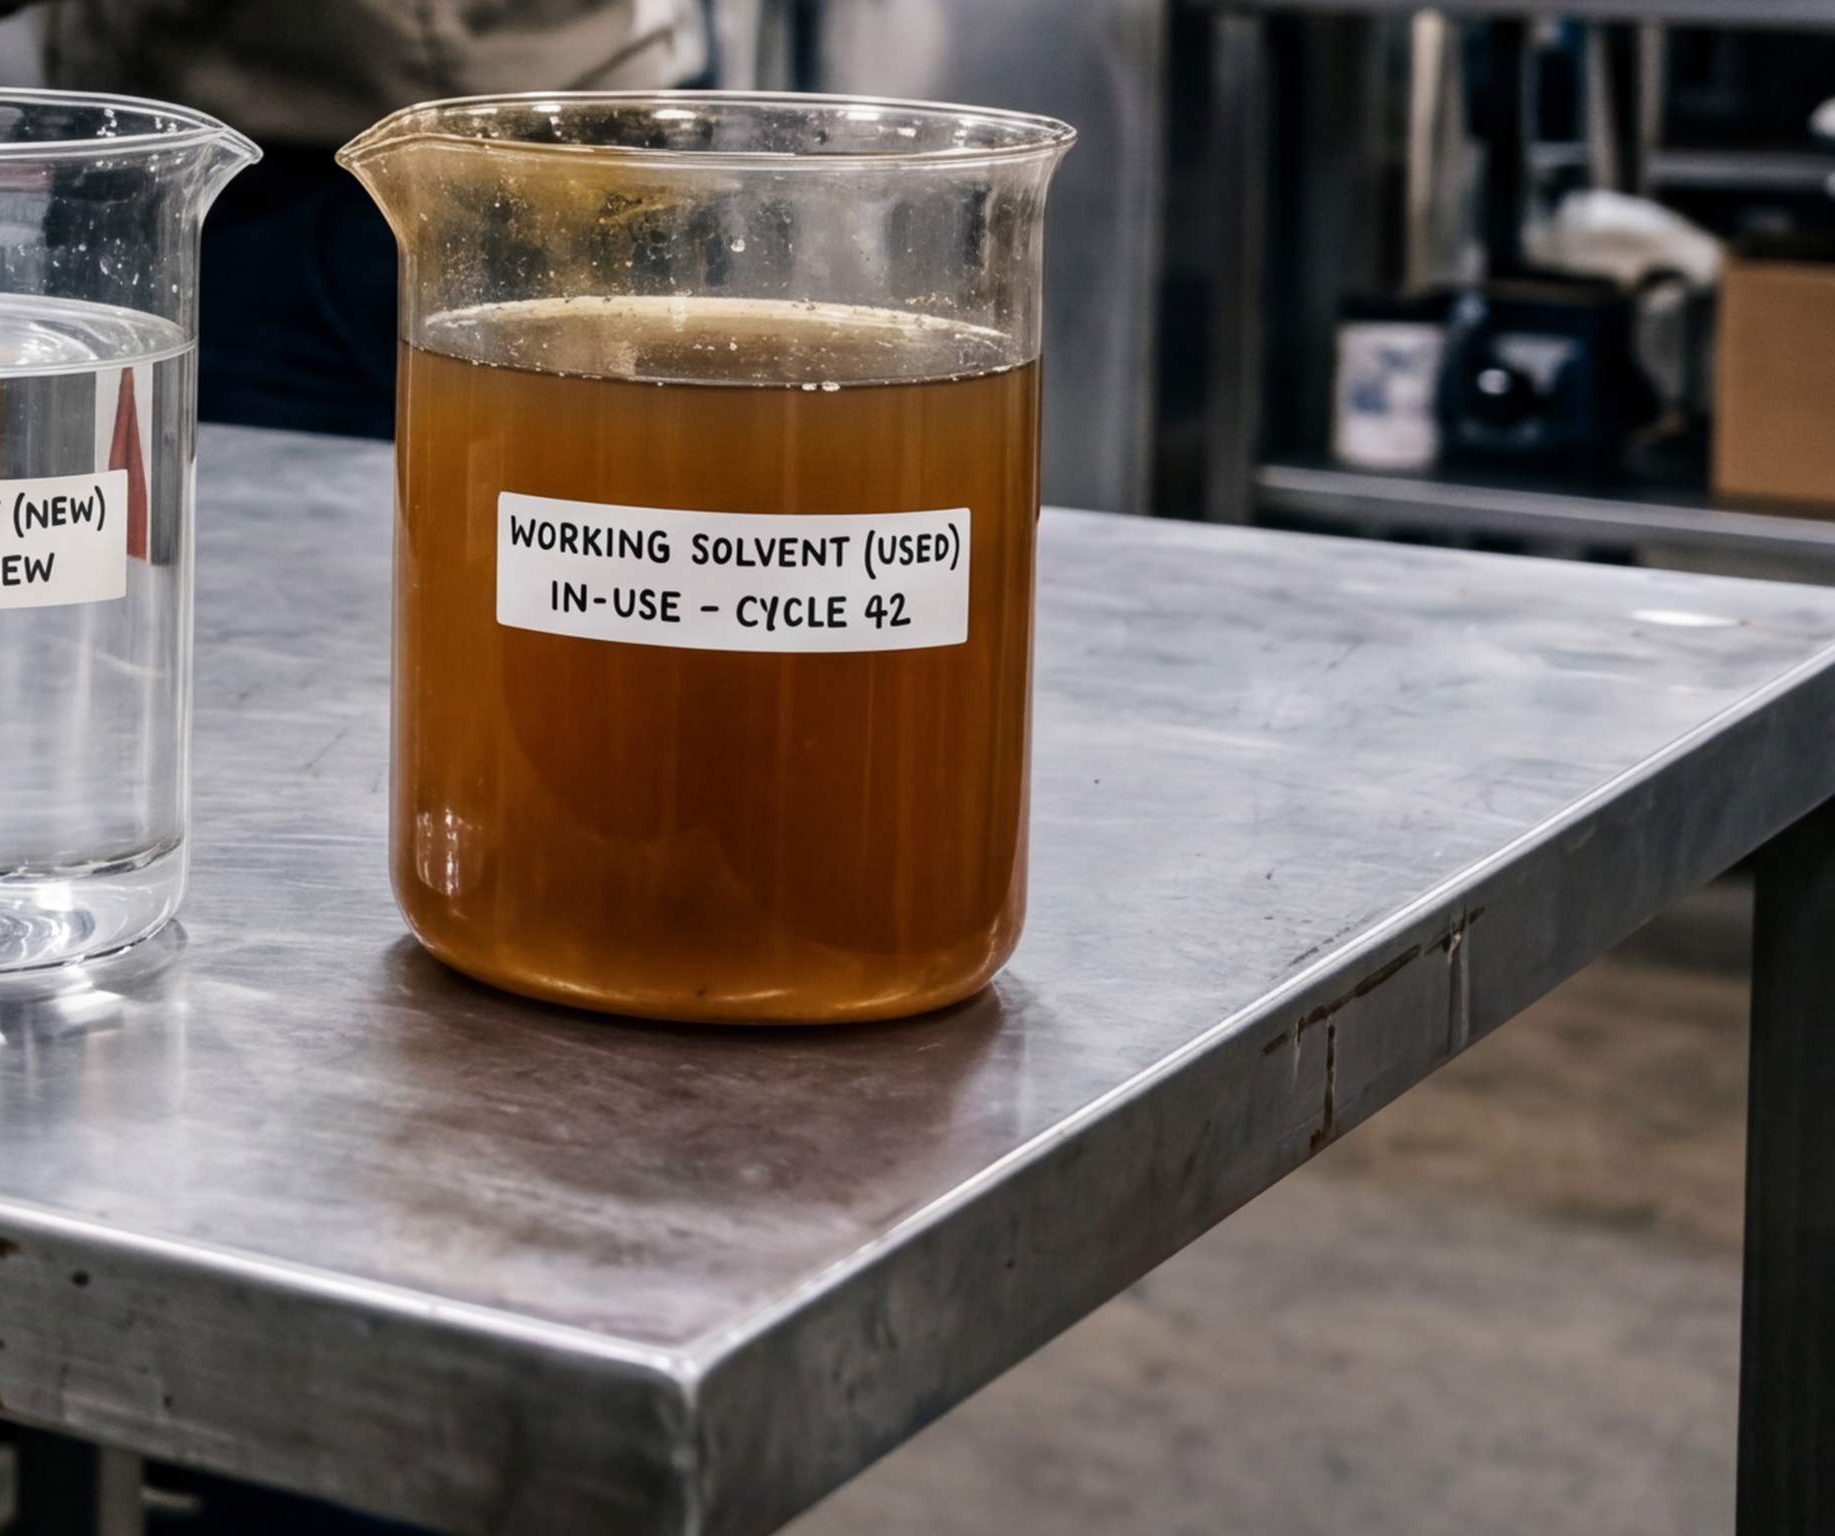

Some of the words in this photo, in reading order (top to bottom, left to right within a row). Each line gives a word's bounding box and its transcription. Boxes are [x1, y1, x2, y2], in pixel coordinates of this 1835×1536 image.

[13, 485, 105, 538] (NEW)
[510, 515, 671, 564] WORKING
[691, 533, 851, 568] SOLVENT
[864, 522, 960, 580] (USED)
[551, 580, 681, 623] IN-USE
[736, 595, 848, 632] CYCLE
[864, 592, 911, 630] 42
